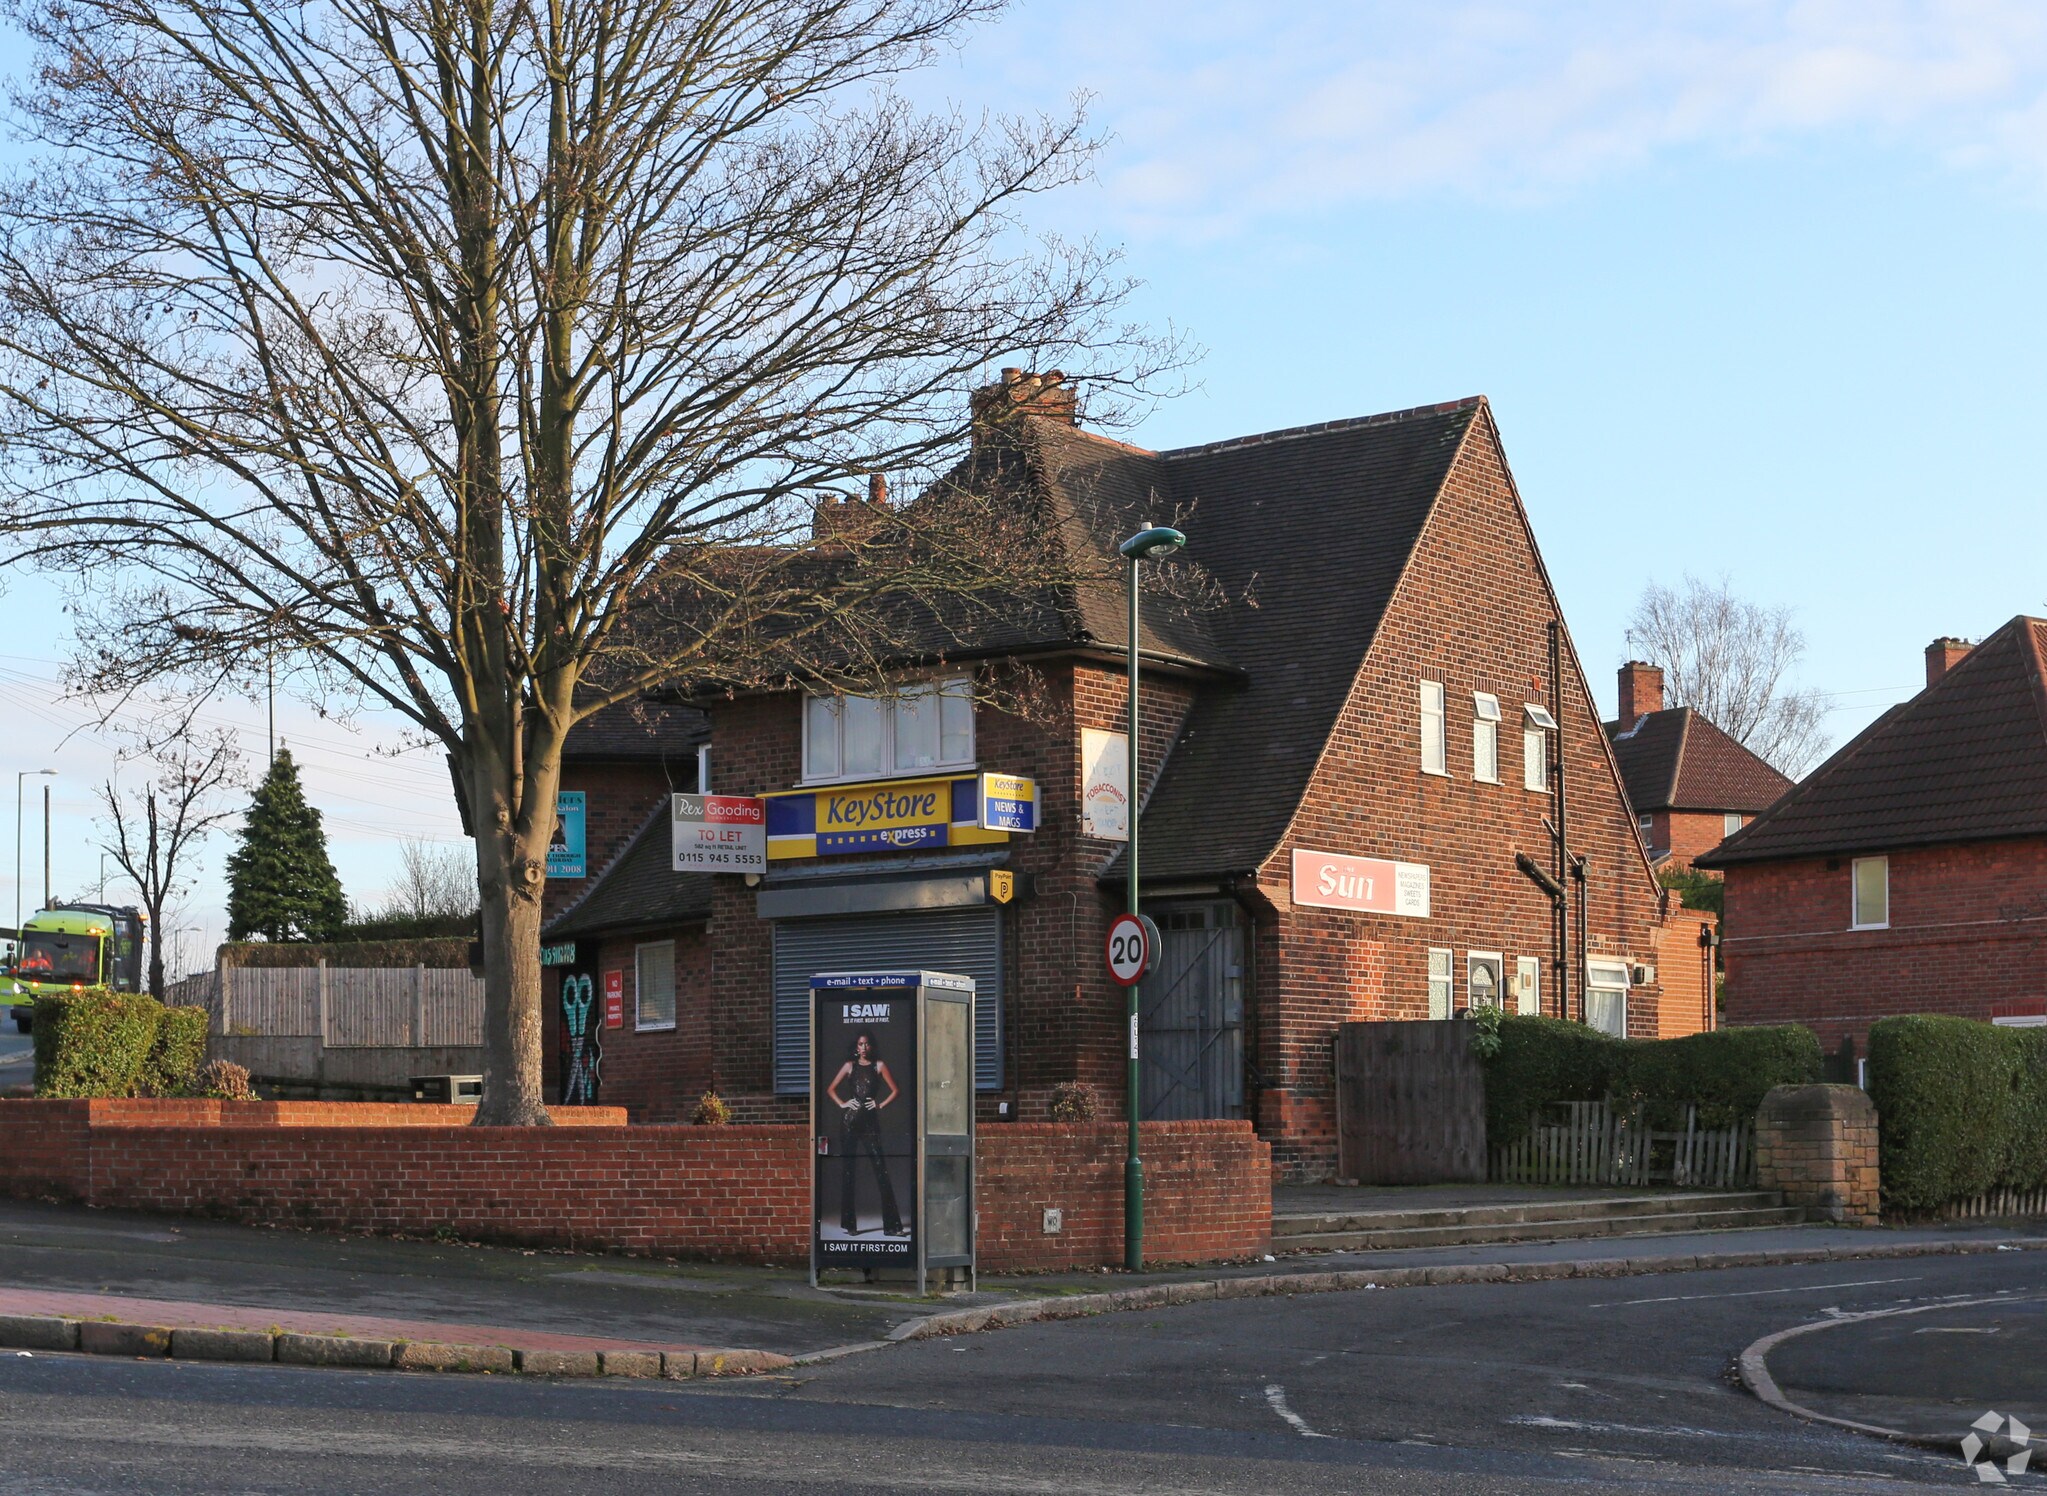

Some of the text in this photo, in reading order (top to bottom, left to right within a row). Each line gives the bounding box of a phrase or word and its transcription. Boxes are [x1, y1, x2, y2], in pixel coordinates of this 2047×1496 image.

[994, 780, 1023, 792] KeyStore
[1086, 783, 1126, 805] TOBACCONIST
[679, 798, 760, 820] Rex Gooding
[827, 792, 937, 826] KeyStore
[994, 801, 1024, 814] NEWS &
[999, 816, 1020, 828] MAGS
[698, 829, 743, 842] TO LET
[880, 827, 927, 845] express
[679, 852, 762, 864] 0115 945 5553
[561, 865, 582, 873] 2008
[1317, 864, 1374, 900] Sun
[1400, 881, 1425, 890] MAGAZINES
[1403, 889, 1422, 899] SWEETS
[1405, 899, 1420, 907] CARDS
[1112, 934, 1142, 964] 20
[826, 977, 851, 986] e-mail
[858, 977, 874, 985] text
[881, 977, 906, 987] phone
[843, 1005, 849, 1017] I
[850, 1004, 888, 1017] SAW
[824, 1243, 908, 1252] I SAW IT FIRST.COM
